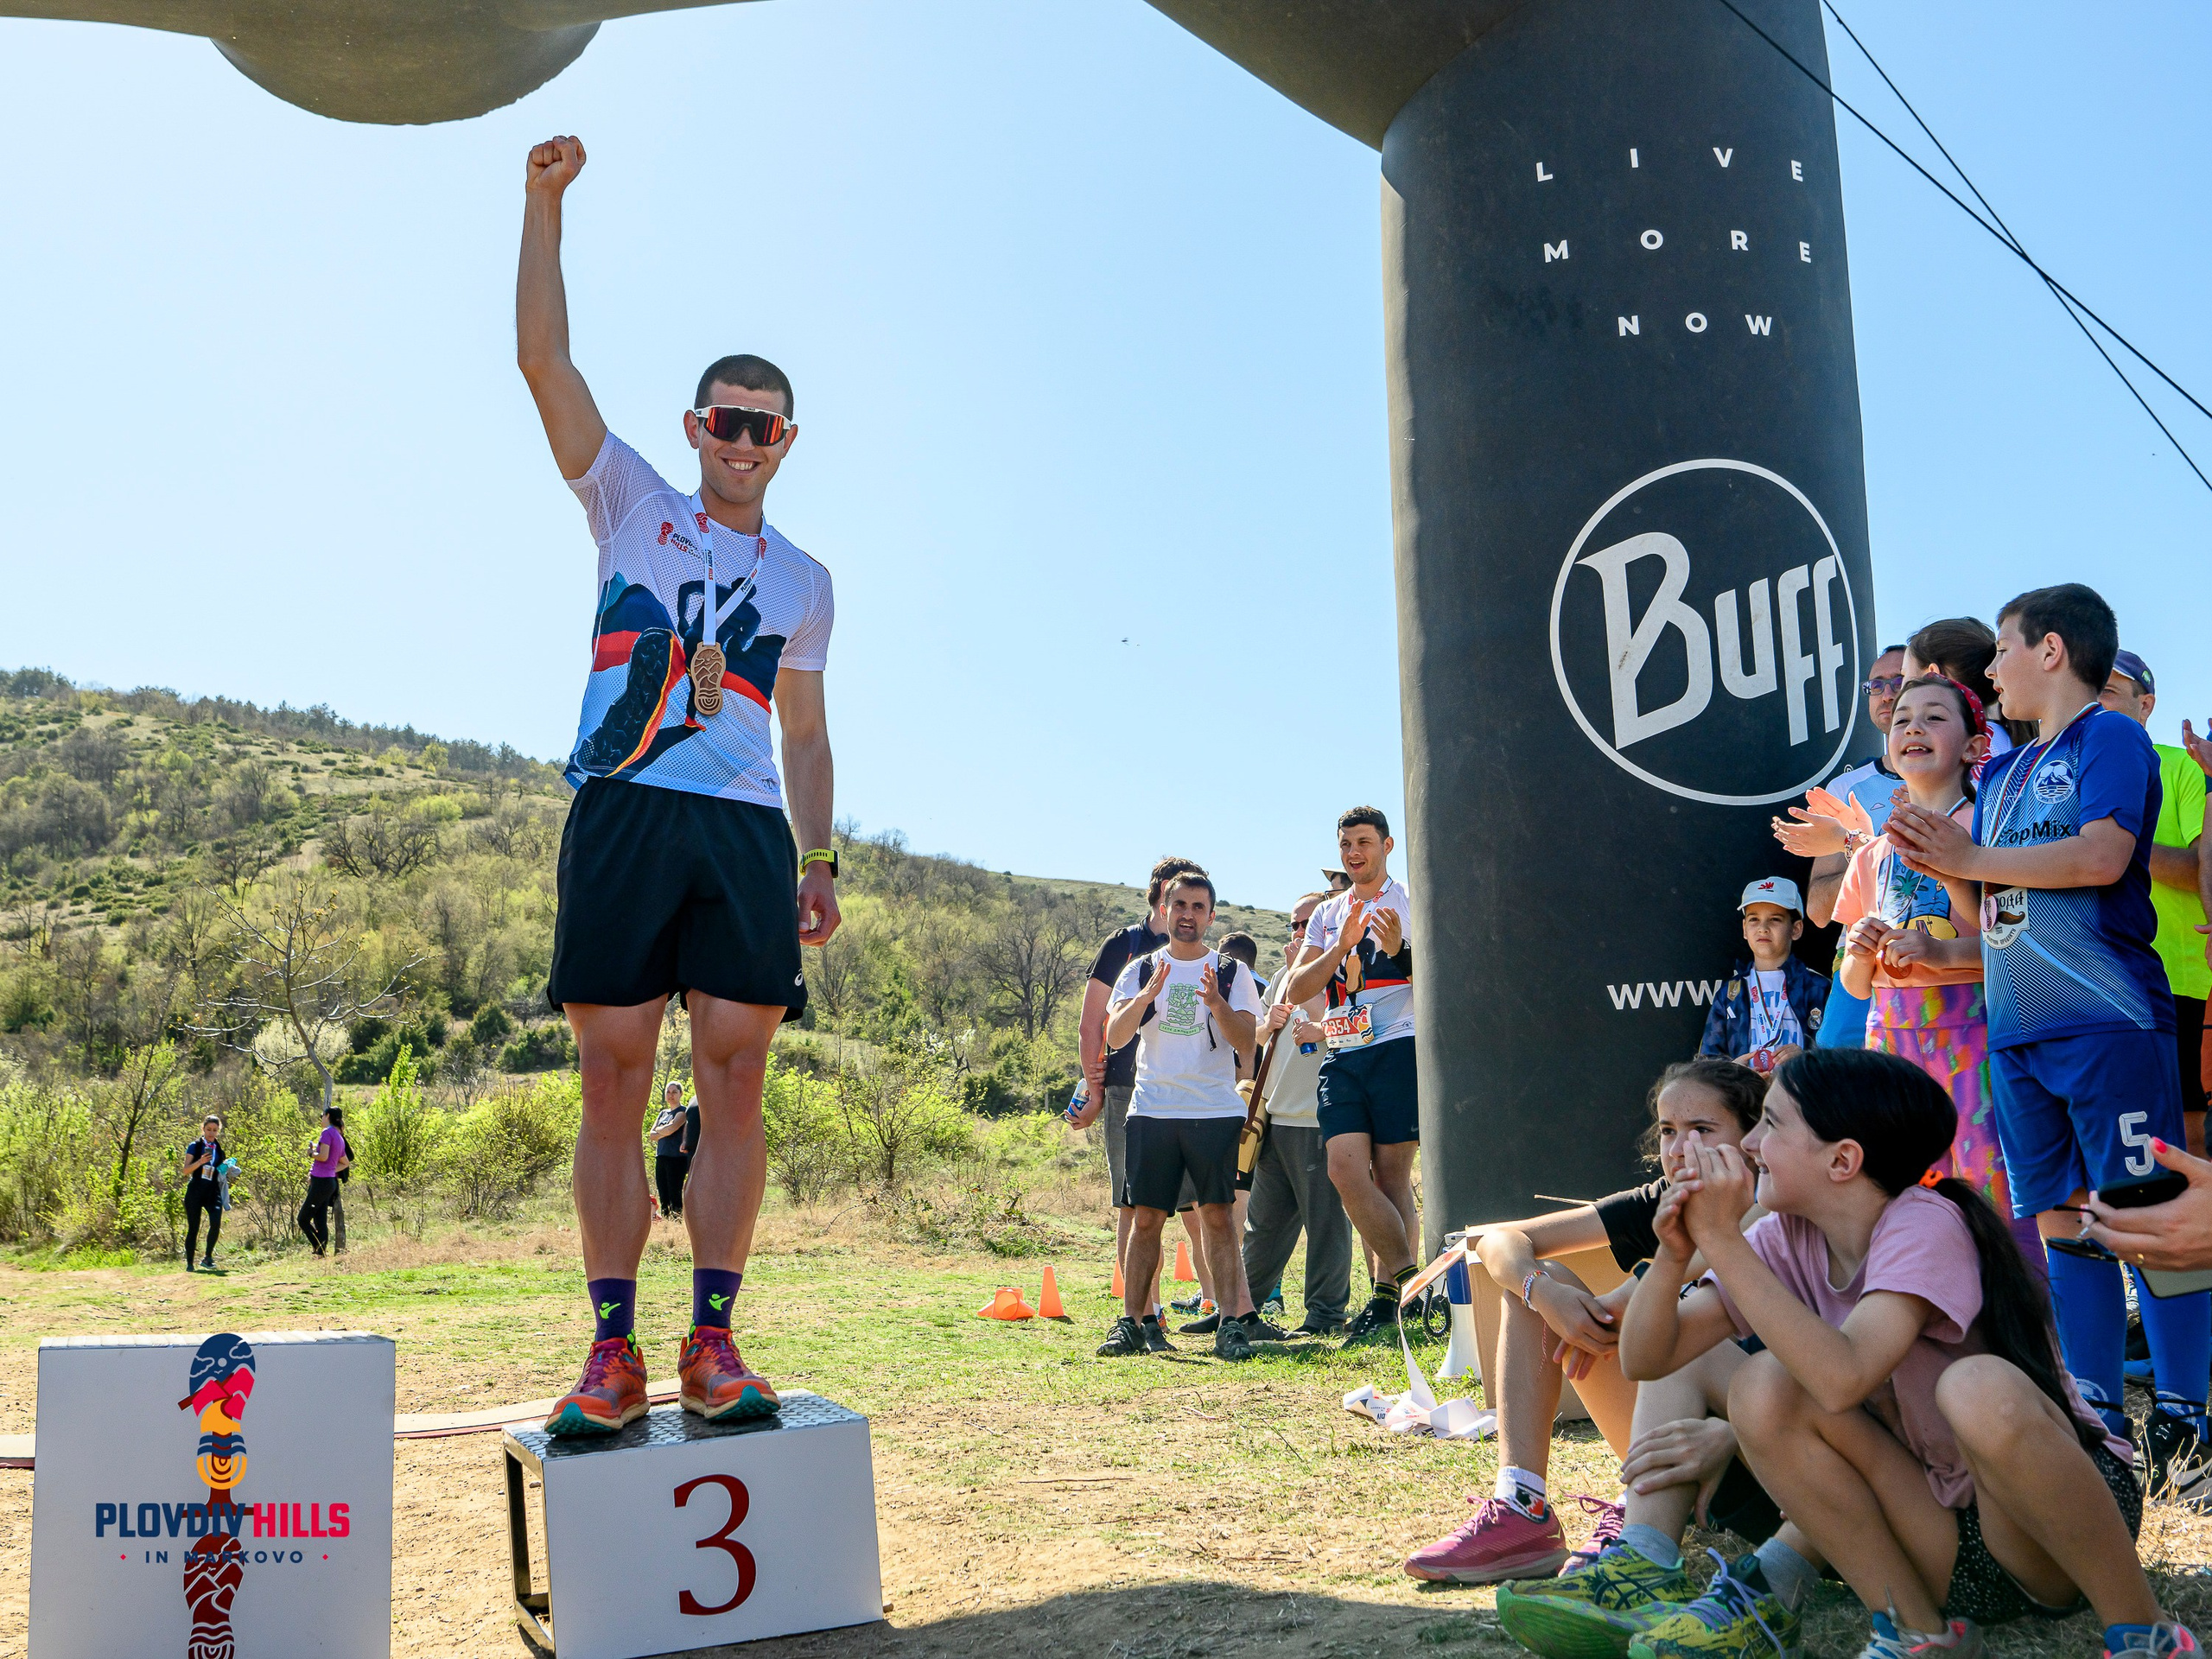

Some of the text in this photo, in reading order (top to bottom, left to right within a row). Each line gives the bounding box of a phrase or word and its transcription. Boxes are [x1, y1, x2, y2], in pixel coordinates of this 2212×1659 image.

[1535, 146, 1803, 182] LIVE
[1543, 229, 1811, 264] MORE
[1617, 312, 1772, 338] NOW
[1322, 1018, 1351, 1038] 2354
[2118, 1110, 2155, 1176] 5
[673, 1473, 757, 1616] 3
